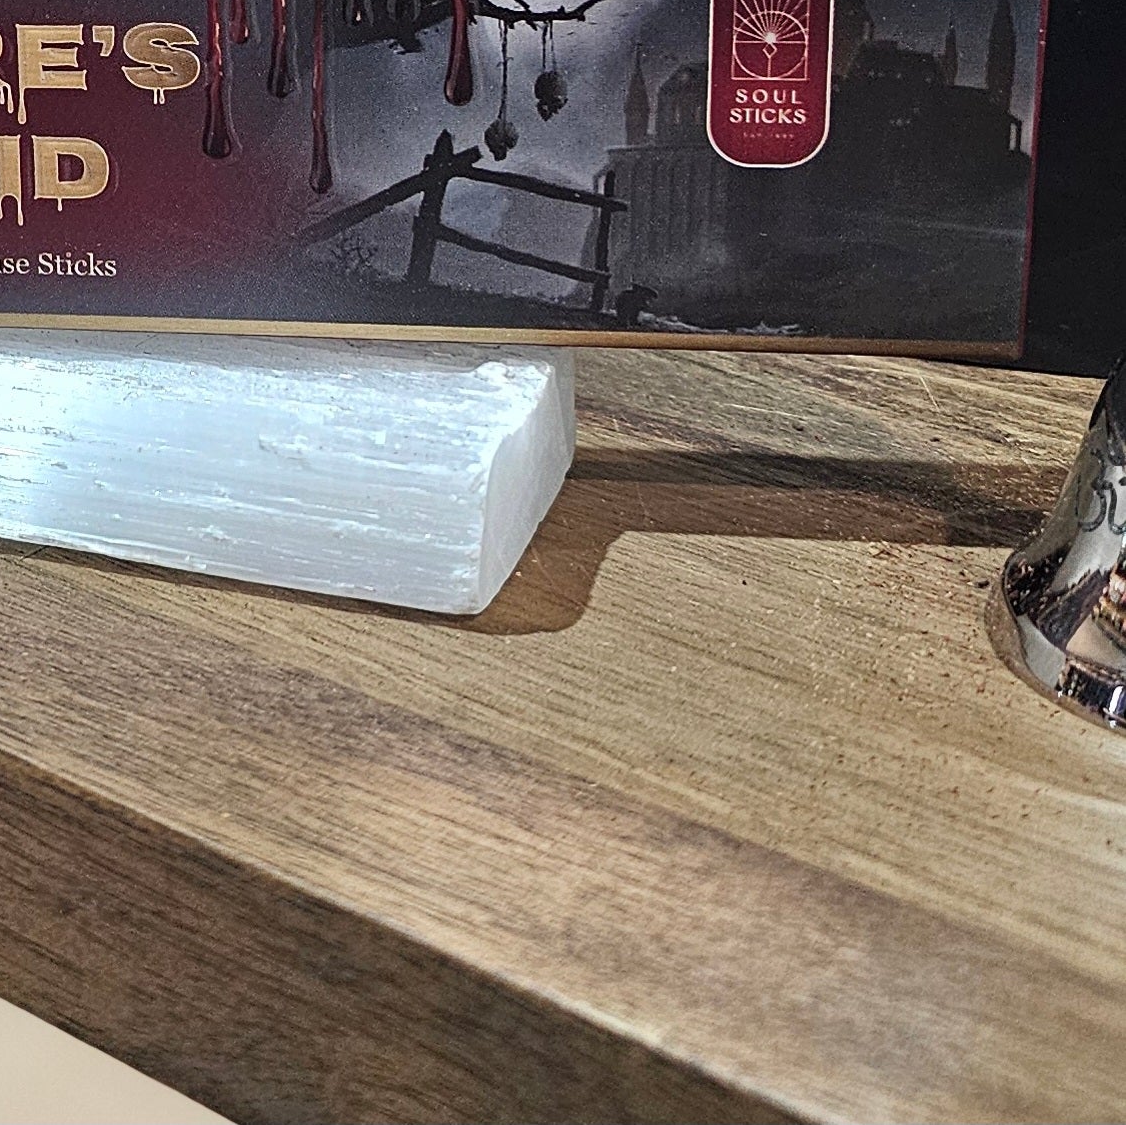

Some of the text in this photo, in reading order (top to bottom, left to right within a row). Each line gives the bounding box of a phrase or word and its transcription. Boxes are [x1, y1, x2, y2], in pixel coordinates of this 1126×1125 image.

[735, 89, 803, 105] SOUL
[729, 107, 807, 125] STICKS
[37, 253, 117, 278] Sticks
